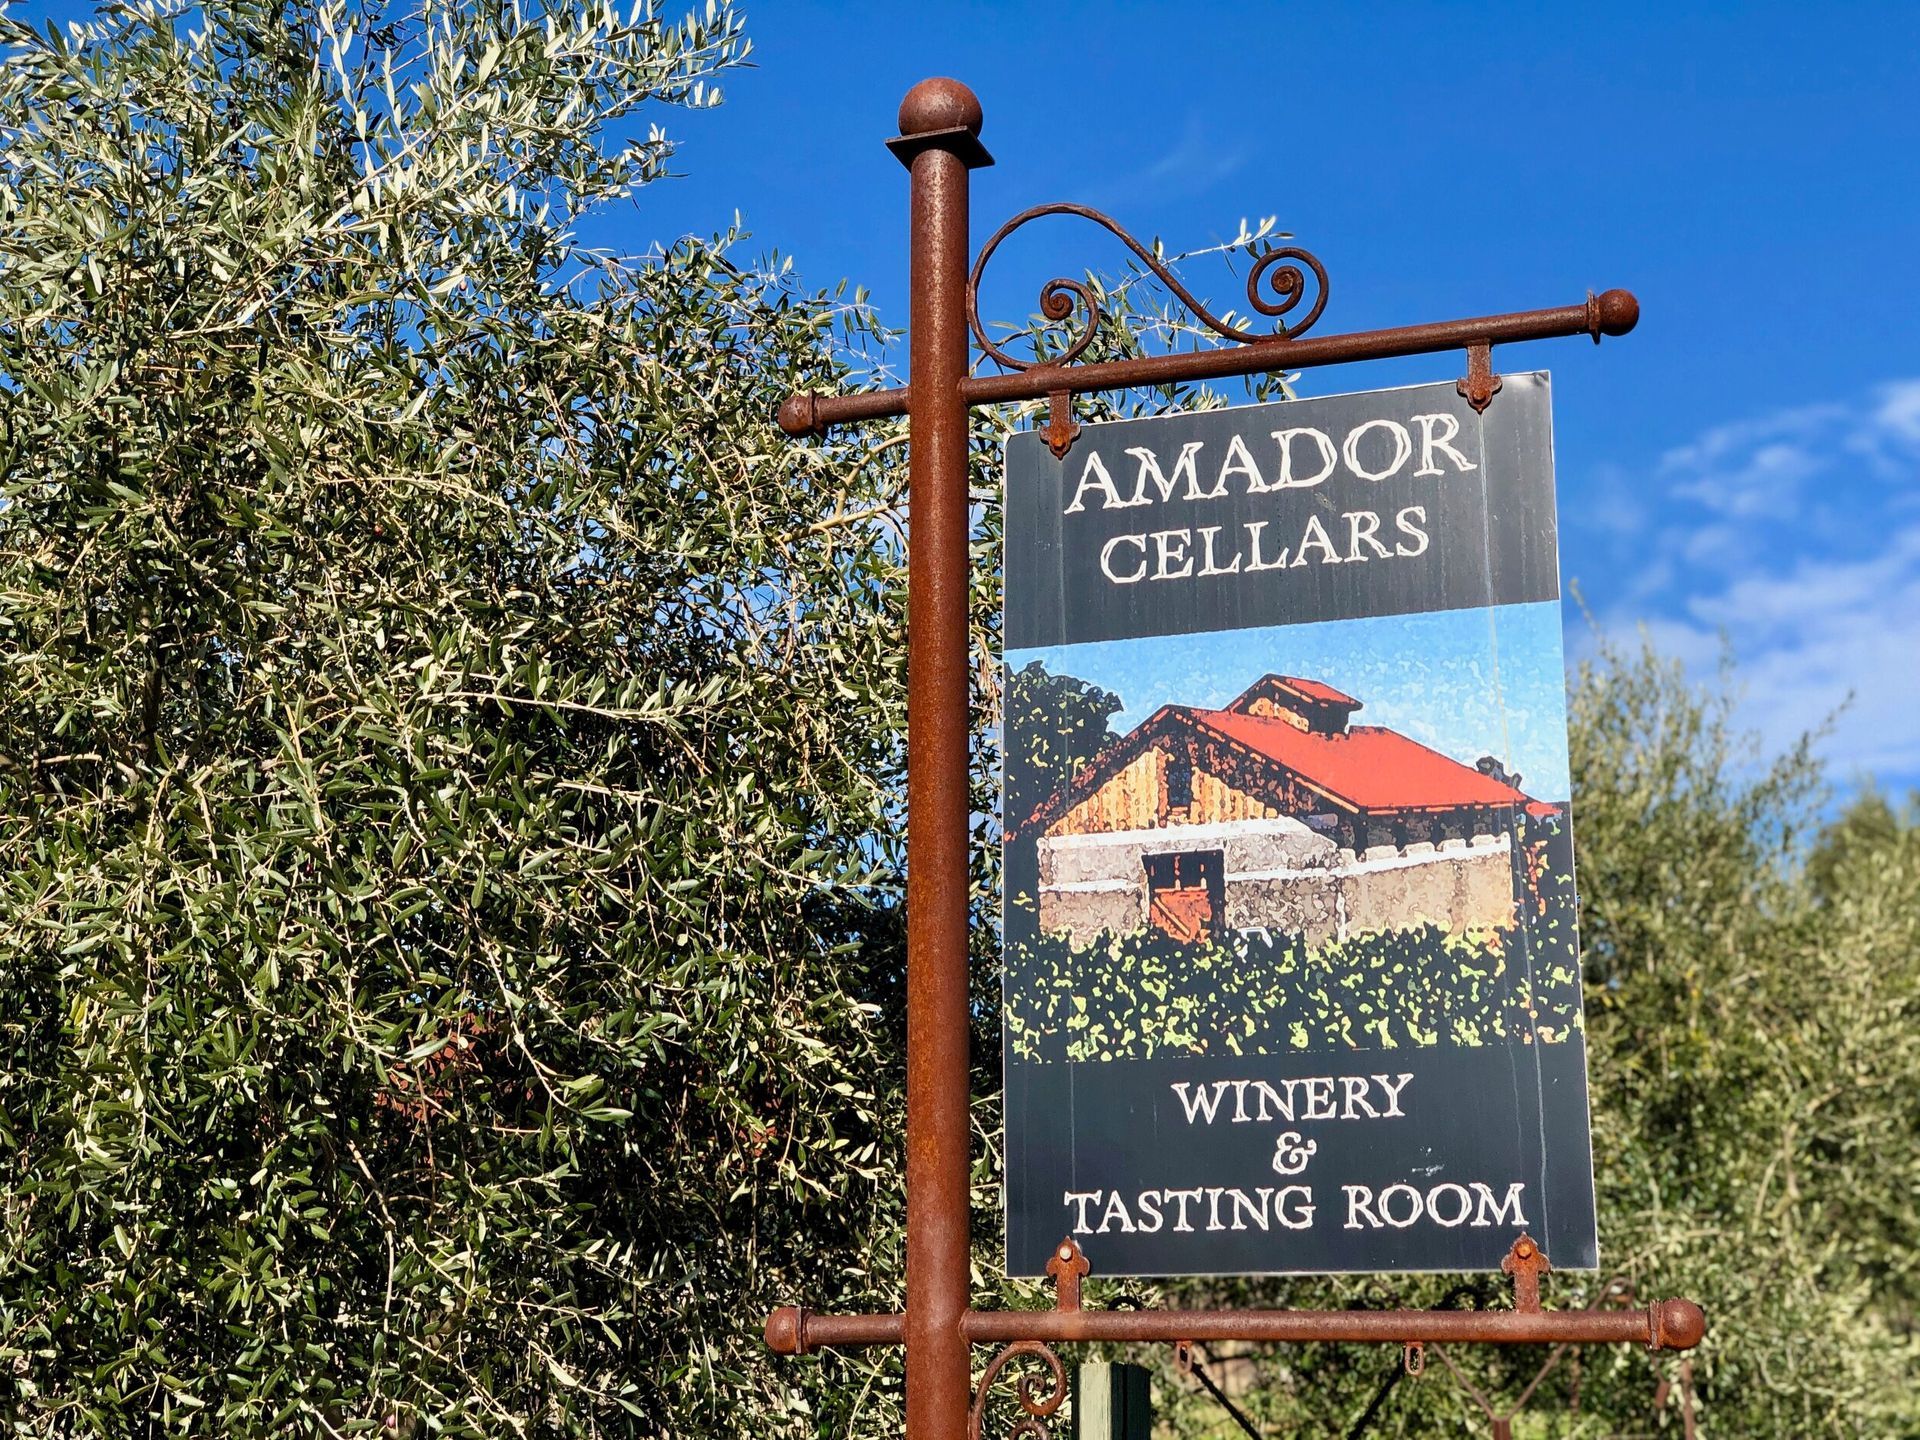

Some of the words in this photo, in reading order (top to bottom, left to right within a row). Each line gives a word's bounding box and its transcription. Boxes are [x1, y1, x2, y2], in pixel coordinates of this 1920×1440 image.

[1064, 412, 1478, 515] AMADOR
[1100, 504, 1430, 584] CELLARS
[1171, 1073, 1415, 1124] WINERY
[1273, 1132, 1317, 1176] &
[1063, 1186, 1317, 1235] TASTING
[1342, 1183, 1530, 1230] ROOM
